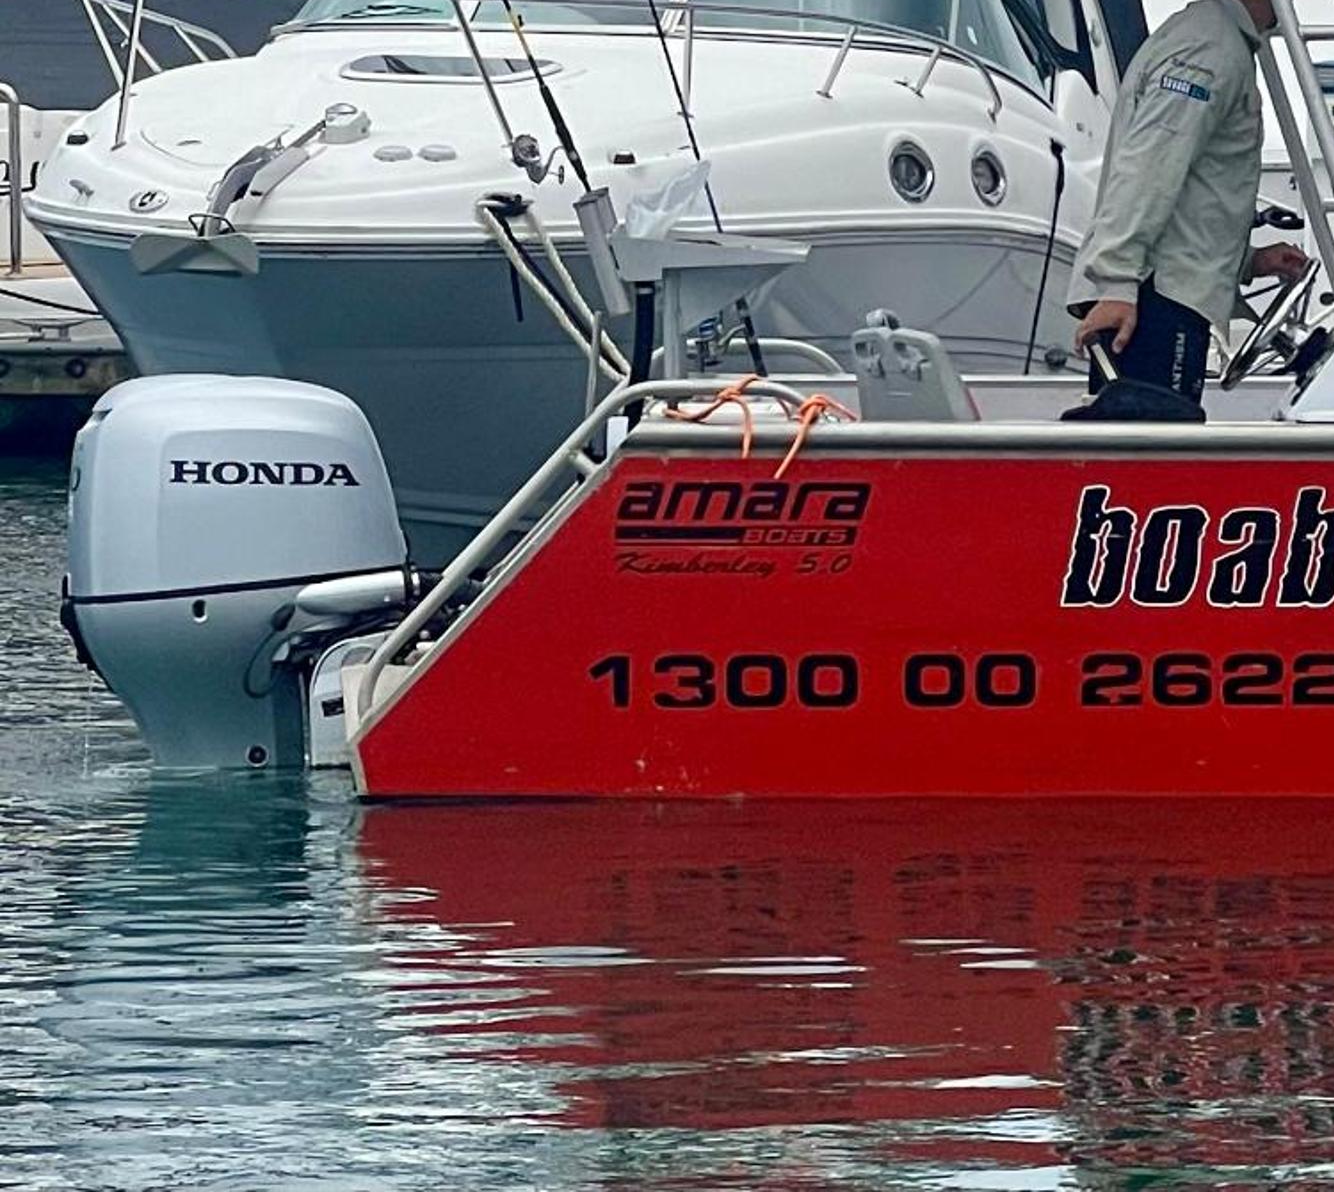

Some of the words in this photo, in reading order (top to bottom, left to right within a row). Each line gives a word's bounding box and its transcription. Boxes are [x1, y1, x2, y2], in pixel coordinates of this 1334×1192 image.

[170, 461, 360, 486] HONDA
[617, 481, 872, 521] amara
[590, 655, 858, 707] 1300
[905, 654, 1036, 707] 00
